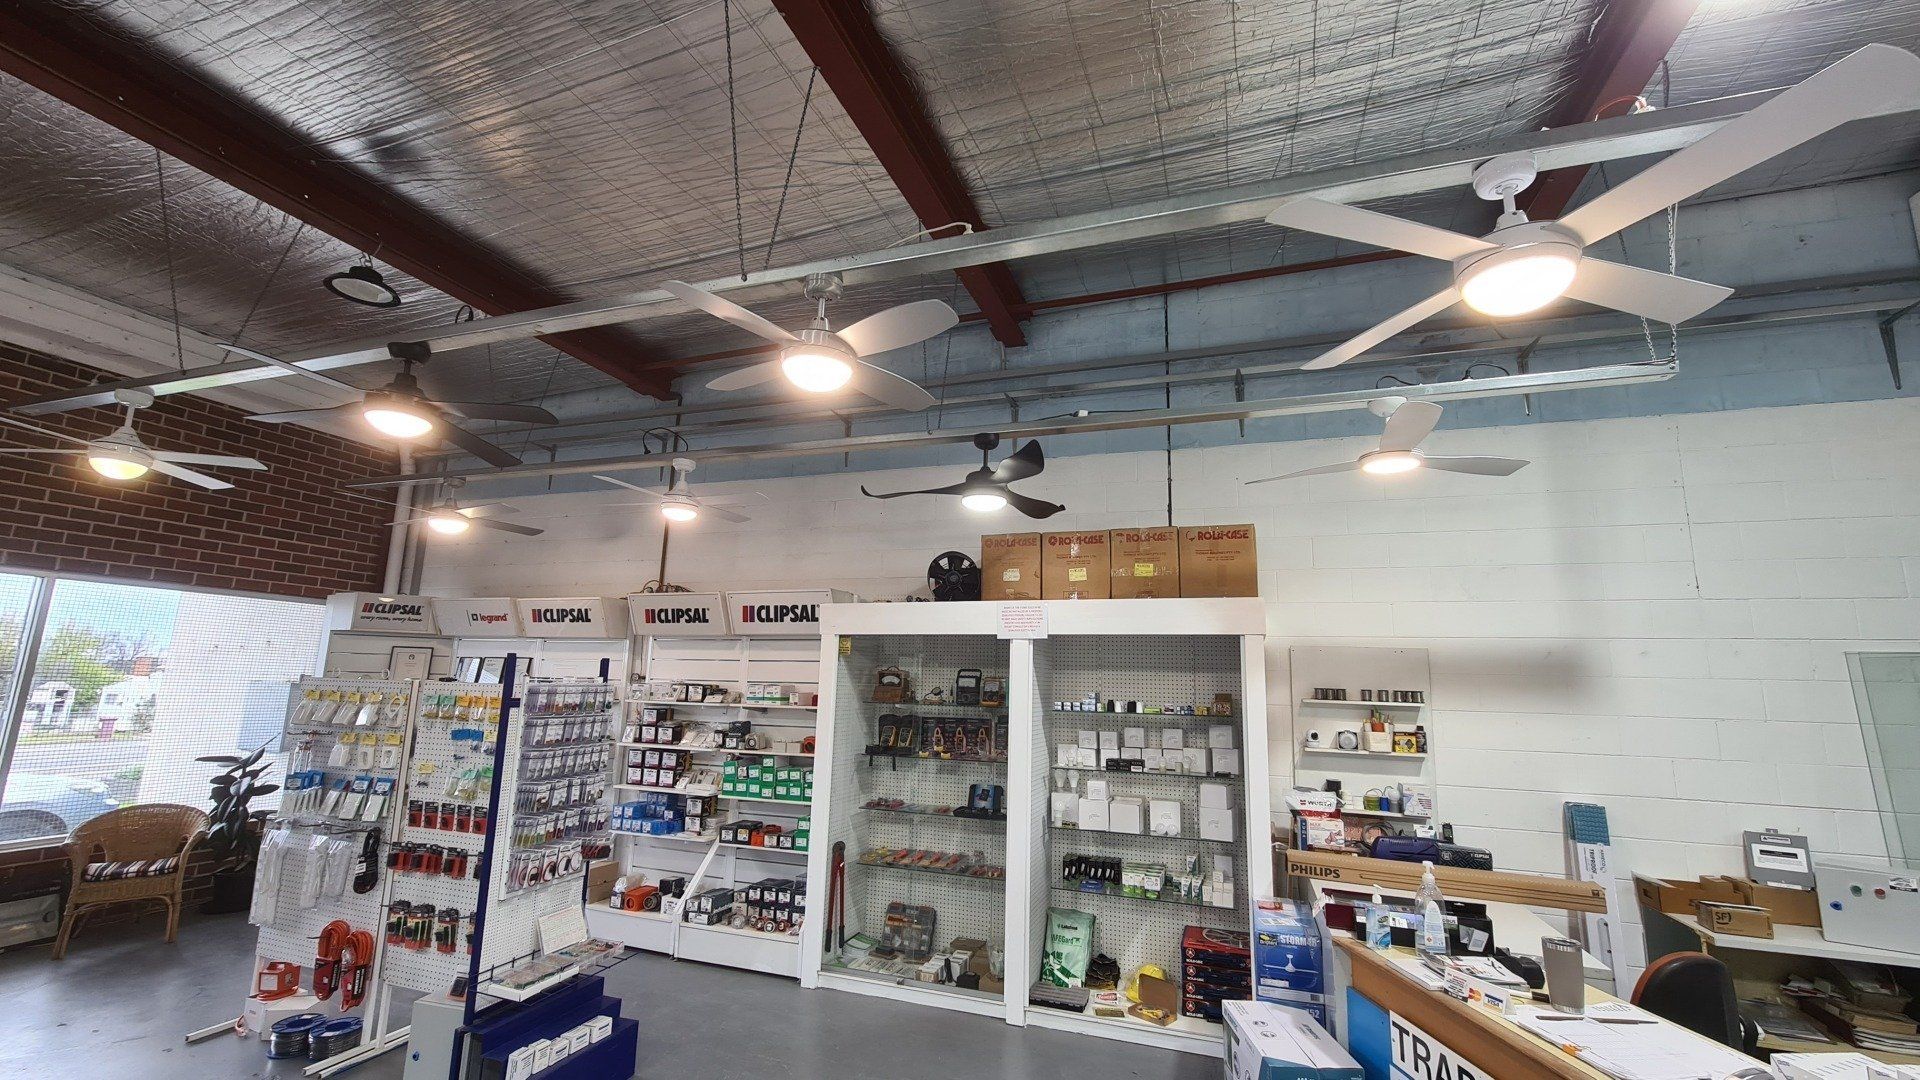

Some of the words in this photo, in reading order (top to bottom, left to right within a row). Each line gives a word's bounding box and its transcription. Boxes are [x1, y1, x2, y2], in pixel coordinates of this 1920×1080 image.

[1197, 529, 1249, 541] ROLA-CASE
[994, 537, 1037, 548] ROLA-CASE
[374, 602, 422, 616] CLIPSAL
[543, 608, 591, 623] CLIPSAL
[657, 607, 709, 624] CLIPSAL
[756, 604, 819, 623] CLIPSAL
[479, 612, 508, 624] legrand
[1291, 863, 1341, 879] PHILIPS
[1280, 934, 1307, 946] STORM
[1487, 998, 1500, 1008] VISA
